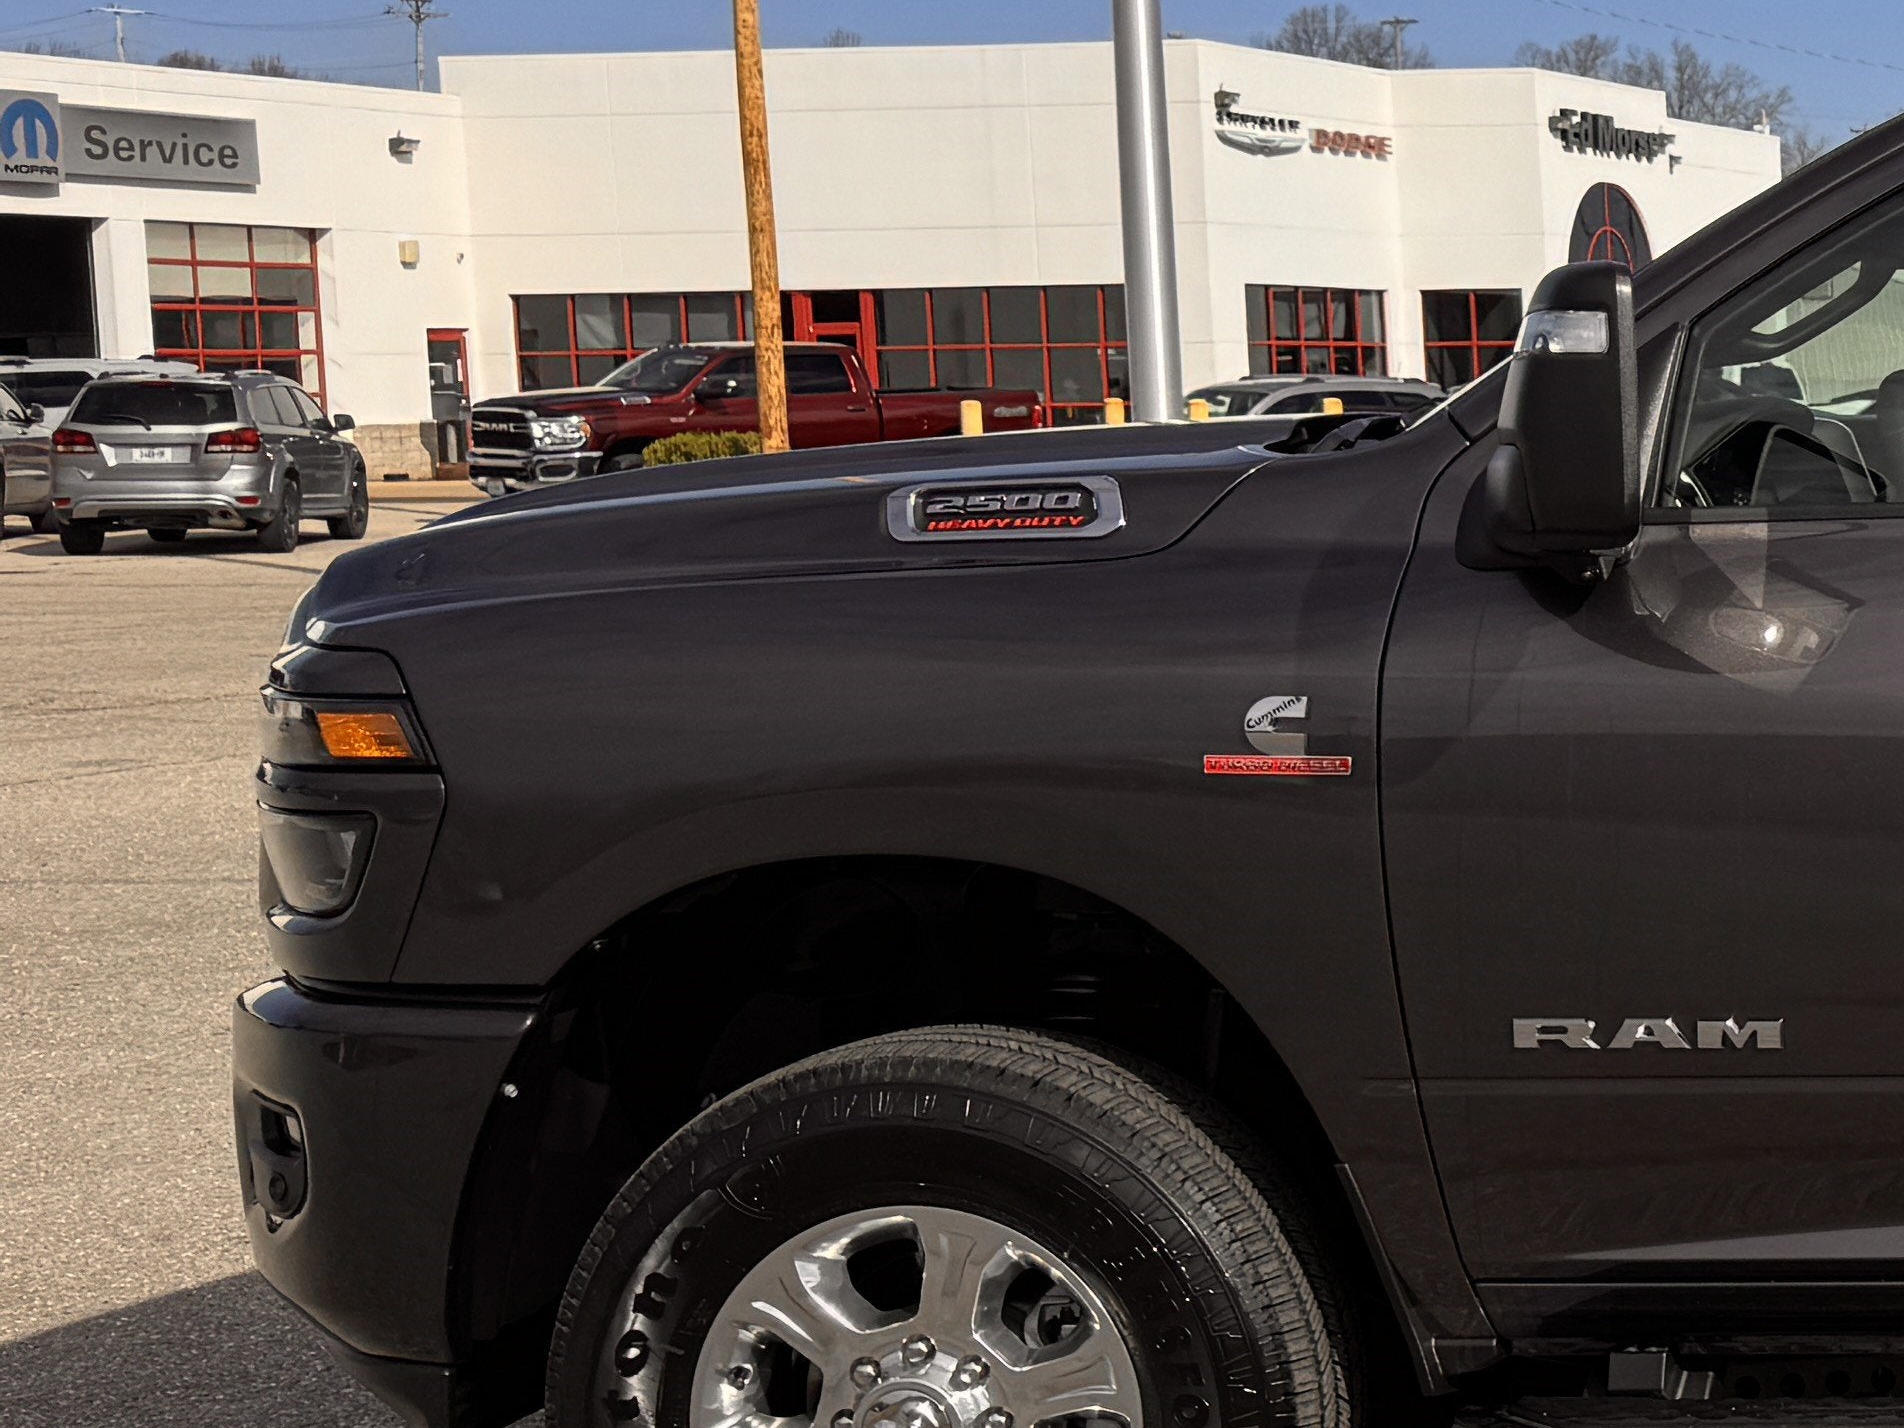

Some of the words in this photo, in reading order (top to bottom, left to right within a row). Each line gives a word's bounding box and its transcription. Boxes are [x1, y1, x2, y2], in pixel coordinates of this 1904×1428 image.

[83, 124, 240, 170] Service
[1308, 129, 1393, 158] DODGE
[1593, 113, 1663, 162] Morse
[4, 163, 59, 176] MOPAR
[926, 492, 1081, 514] 2500
[927, 517, 1011, 532] HEAVY
[1013, 515, 1085, 528] DUTY
[1246, 695, 1304, 730] Cummins
[1513, 1017, 1784, 1049] RAM
